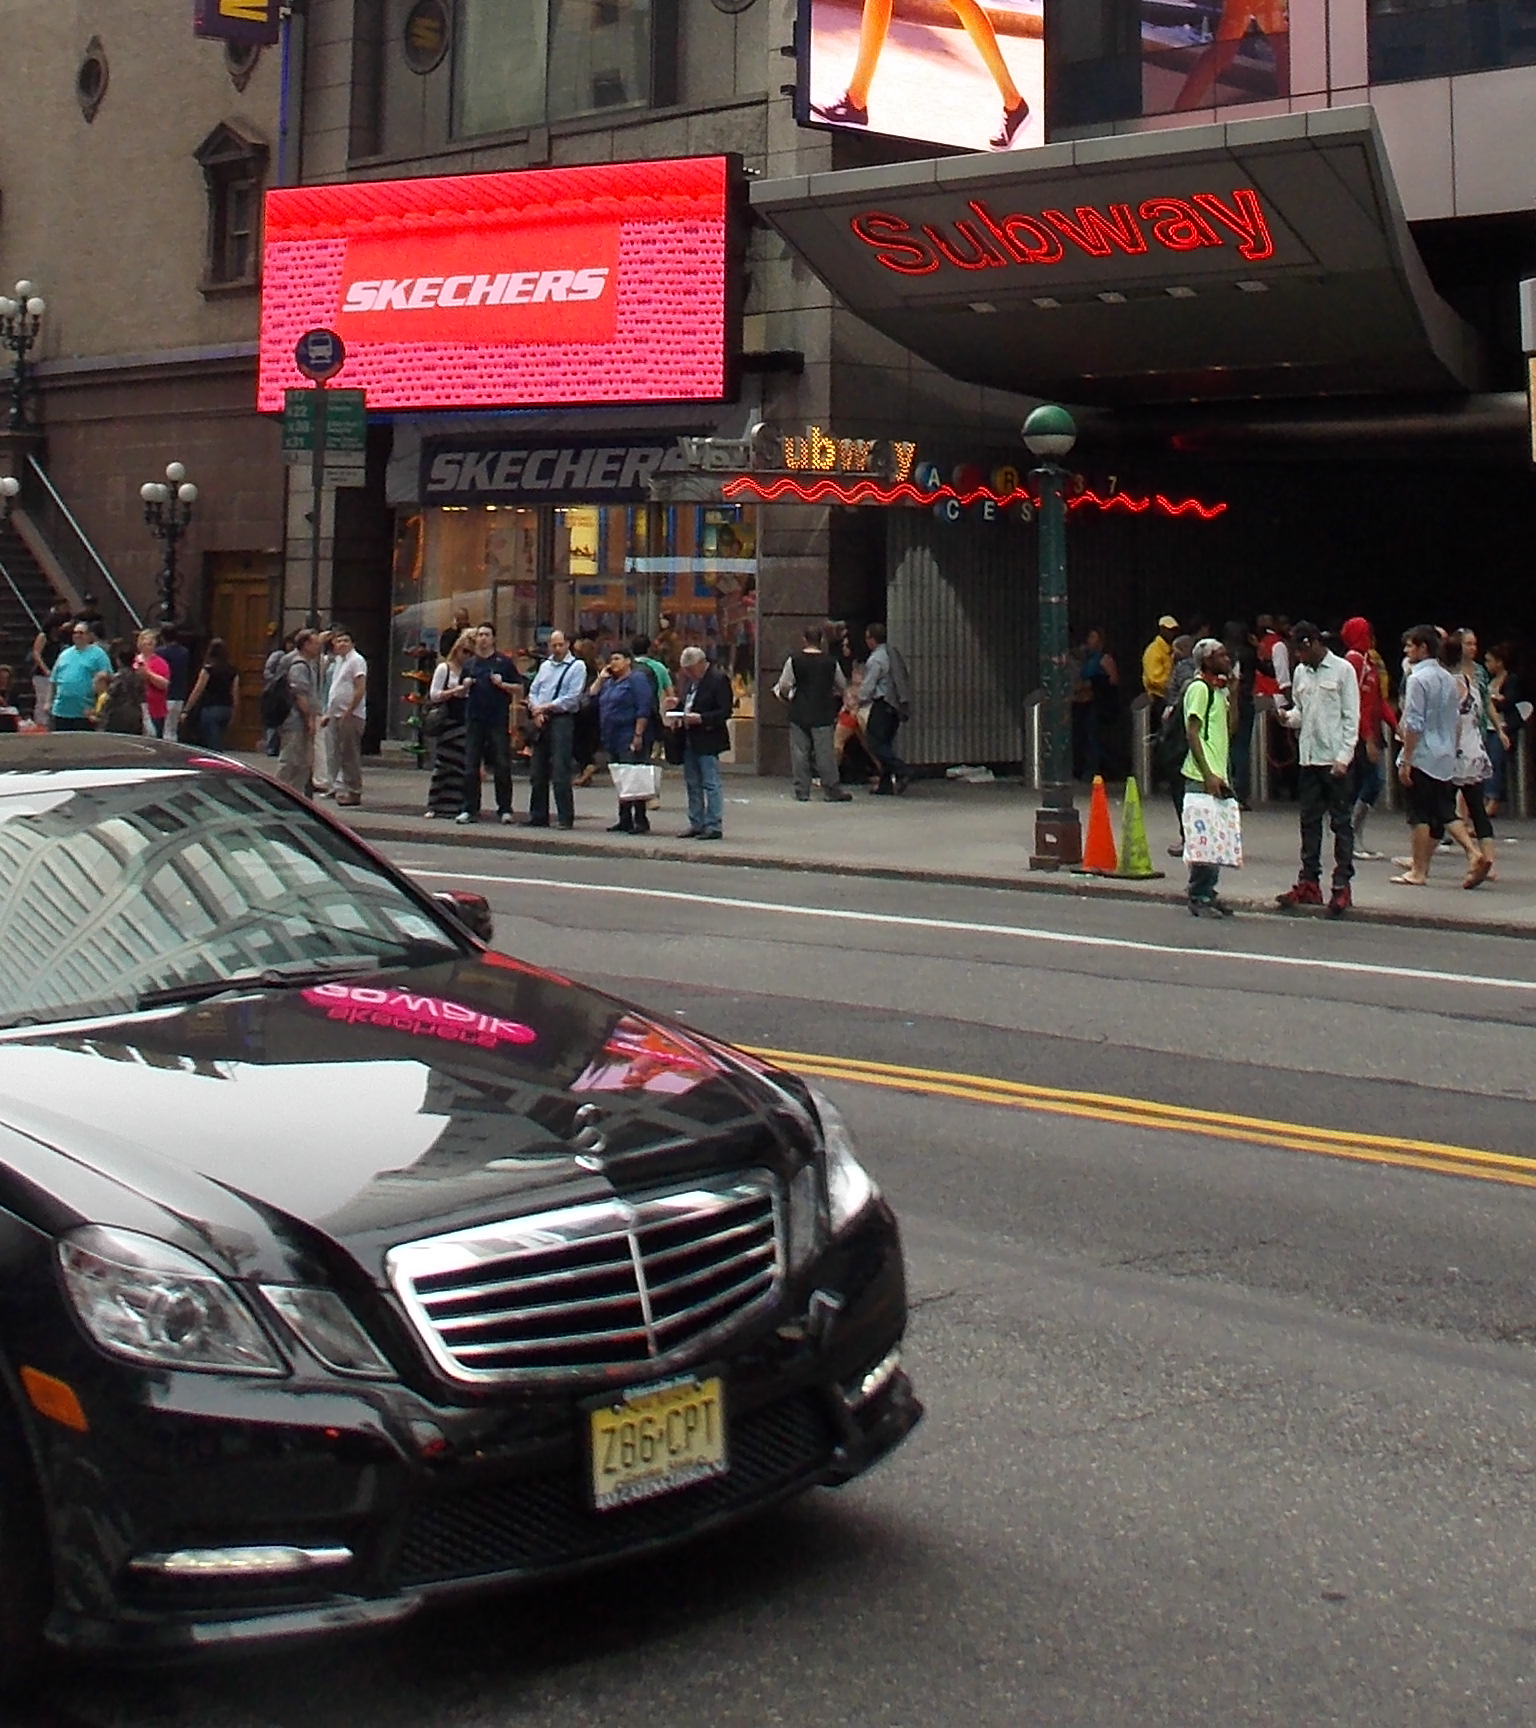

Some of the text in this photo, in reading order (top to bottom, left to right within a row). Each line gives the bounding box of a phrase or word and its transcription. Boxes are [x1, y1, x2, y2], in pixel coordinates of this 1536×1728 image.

[852, 188, 1274, 275] Subway
[342, 267, 609, 313] SKECHERS
[983, 501, 995, 520] E
